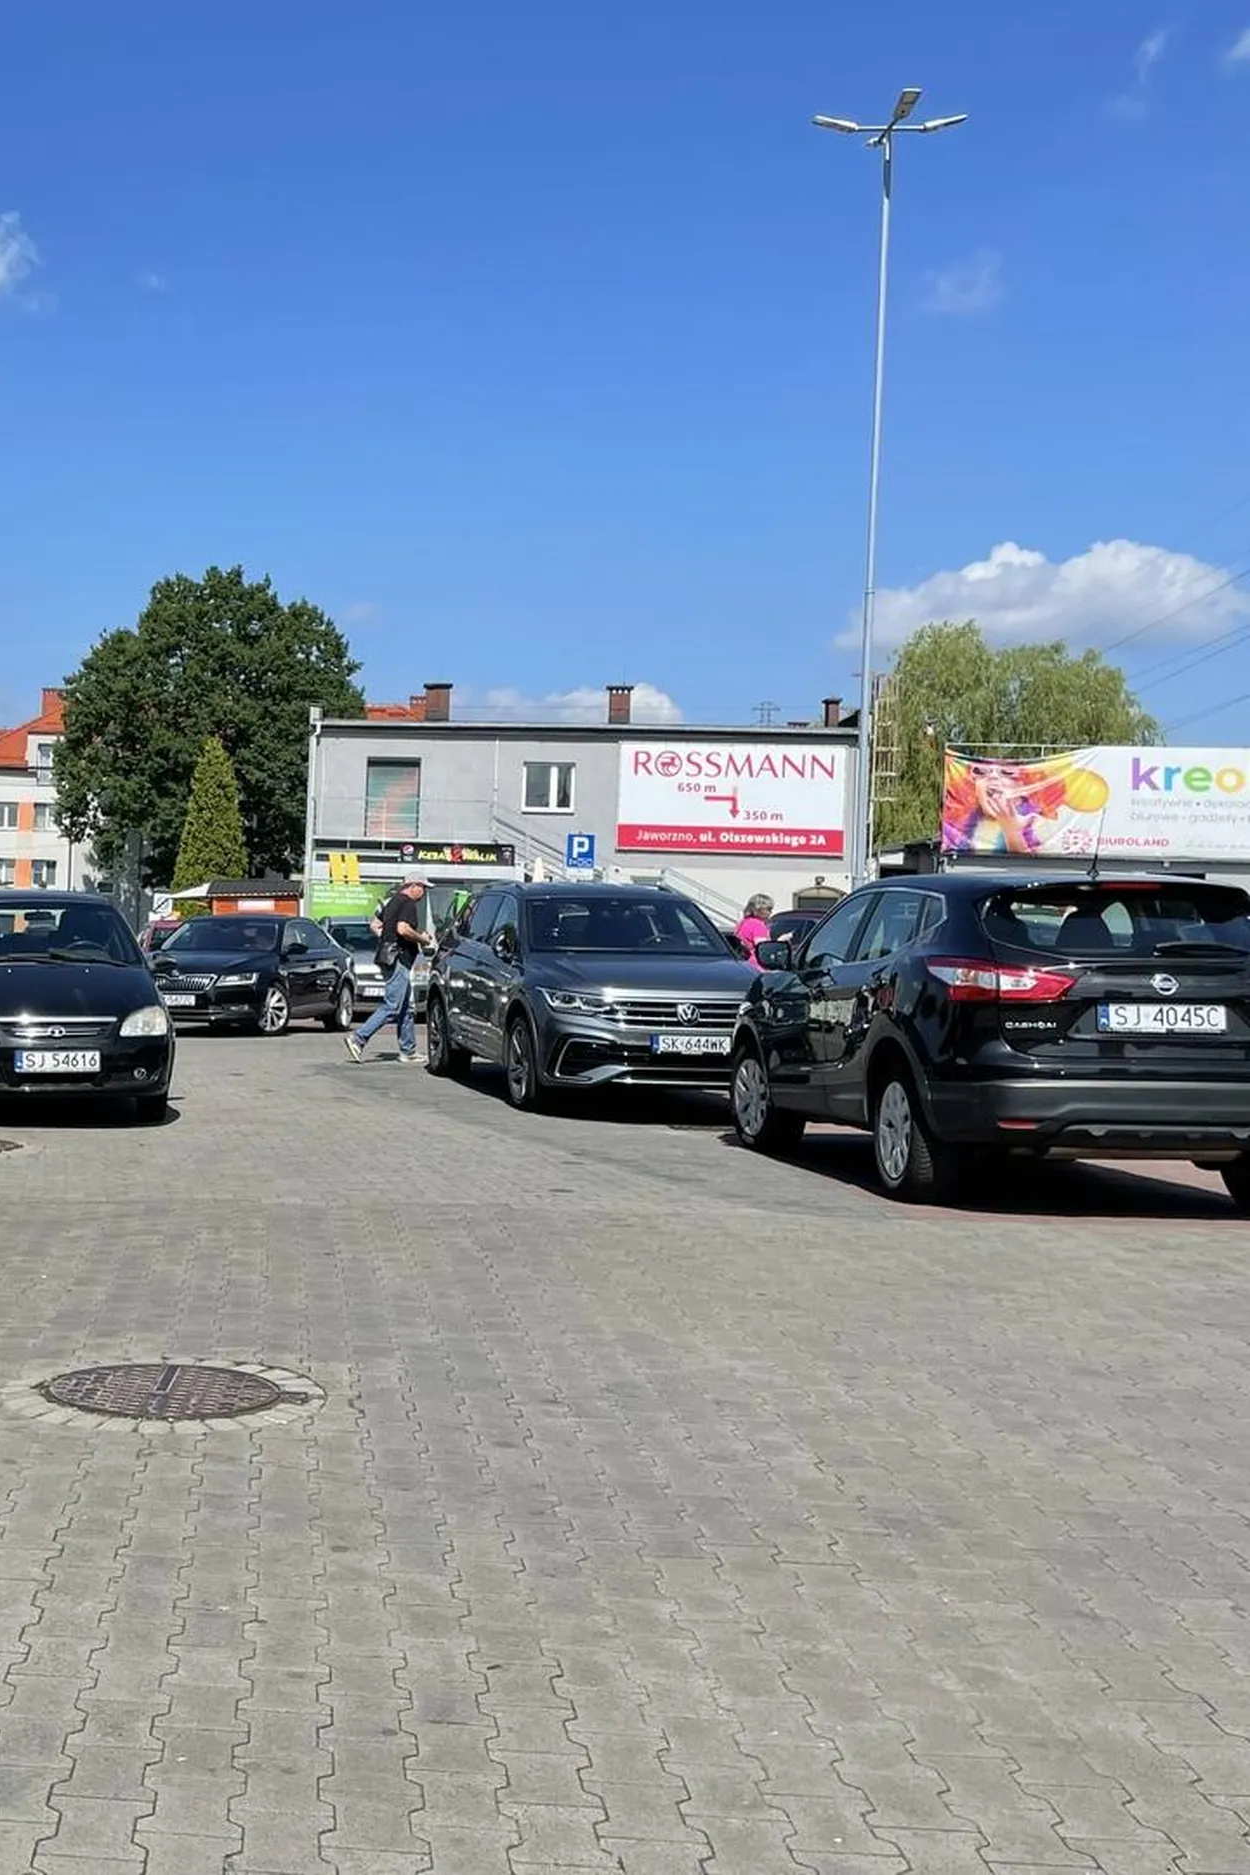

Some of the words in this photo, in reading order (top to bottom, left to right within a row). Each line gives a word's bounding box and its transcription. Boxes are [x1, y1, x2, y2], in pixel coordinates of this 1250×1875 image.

[634, 750, 835, 779] ROSSMANN
[1131, 757, 1245, 793] kreo
[677, 782, 700, 793] 650
[704, 785, 717, 793] m
[743, 810, 767, 821] 350
[770, 813, 784, 821] m
[637, 829, 697, 843] Jaworzno,
[700, 831, 715, 843] ul.
[719, 832, 806, 846] Olszewskiego
[809, 835, 826, 846] 2A
[572, 836, 590, 858] P
[1114, 1007, 1143, 1026] SJ
[1153, 1007, 1219, 1027] 4045C
[662, 1038, 679, 1049] SK
[25, 1054, 46, 1067] SJ
[52, 1054, 97, 1067] 54616
